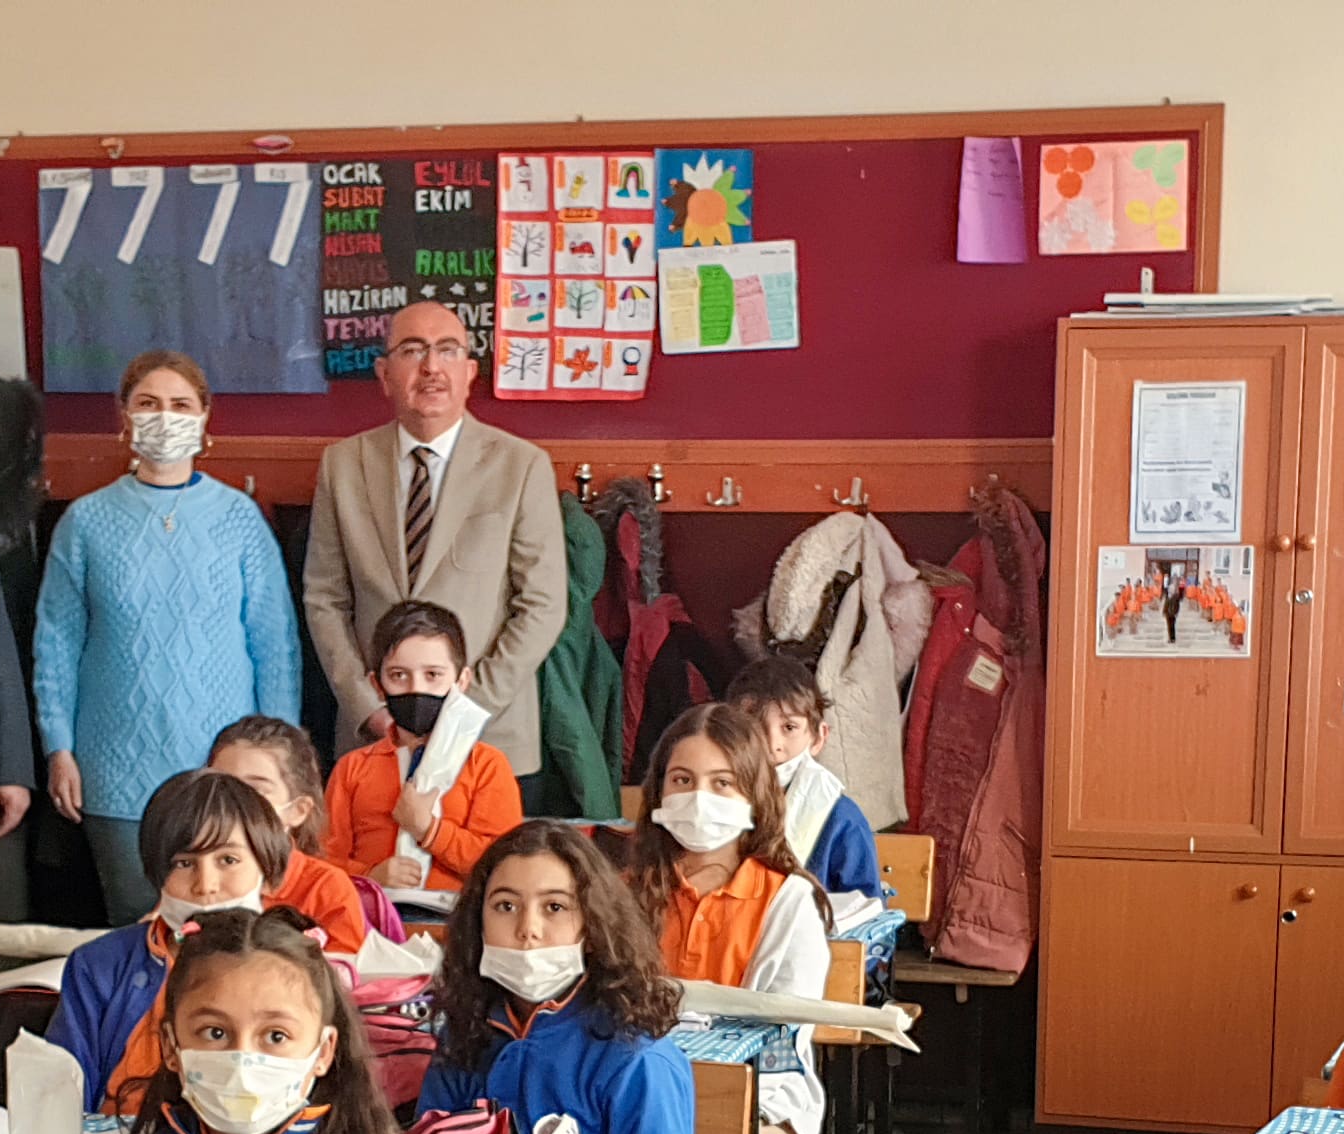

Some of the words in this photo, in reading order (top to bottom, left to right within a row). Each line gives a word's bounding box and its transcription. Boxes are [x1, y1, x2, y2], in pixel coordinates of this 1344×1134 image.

[323, 162, 383, 185] OCAK
[415, 185, 472, 212] EKİM
[325, 208, 380, 233] MART
[415, 248, 496, 276] ARALIK
[323, 284, 408, 315] HAZİRAN
